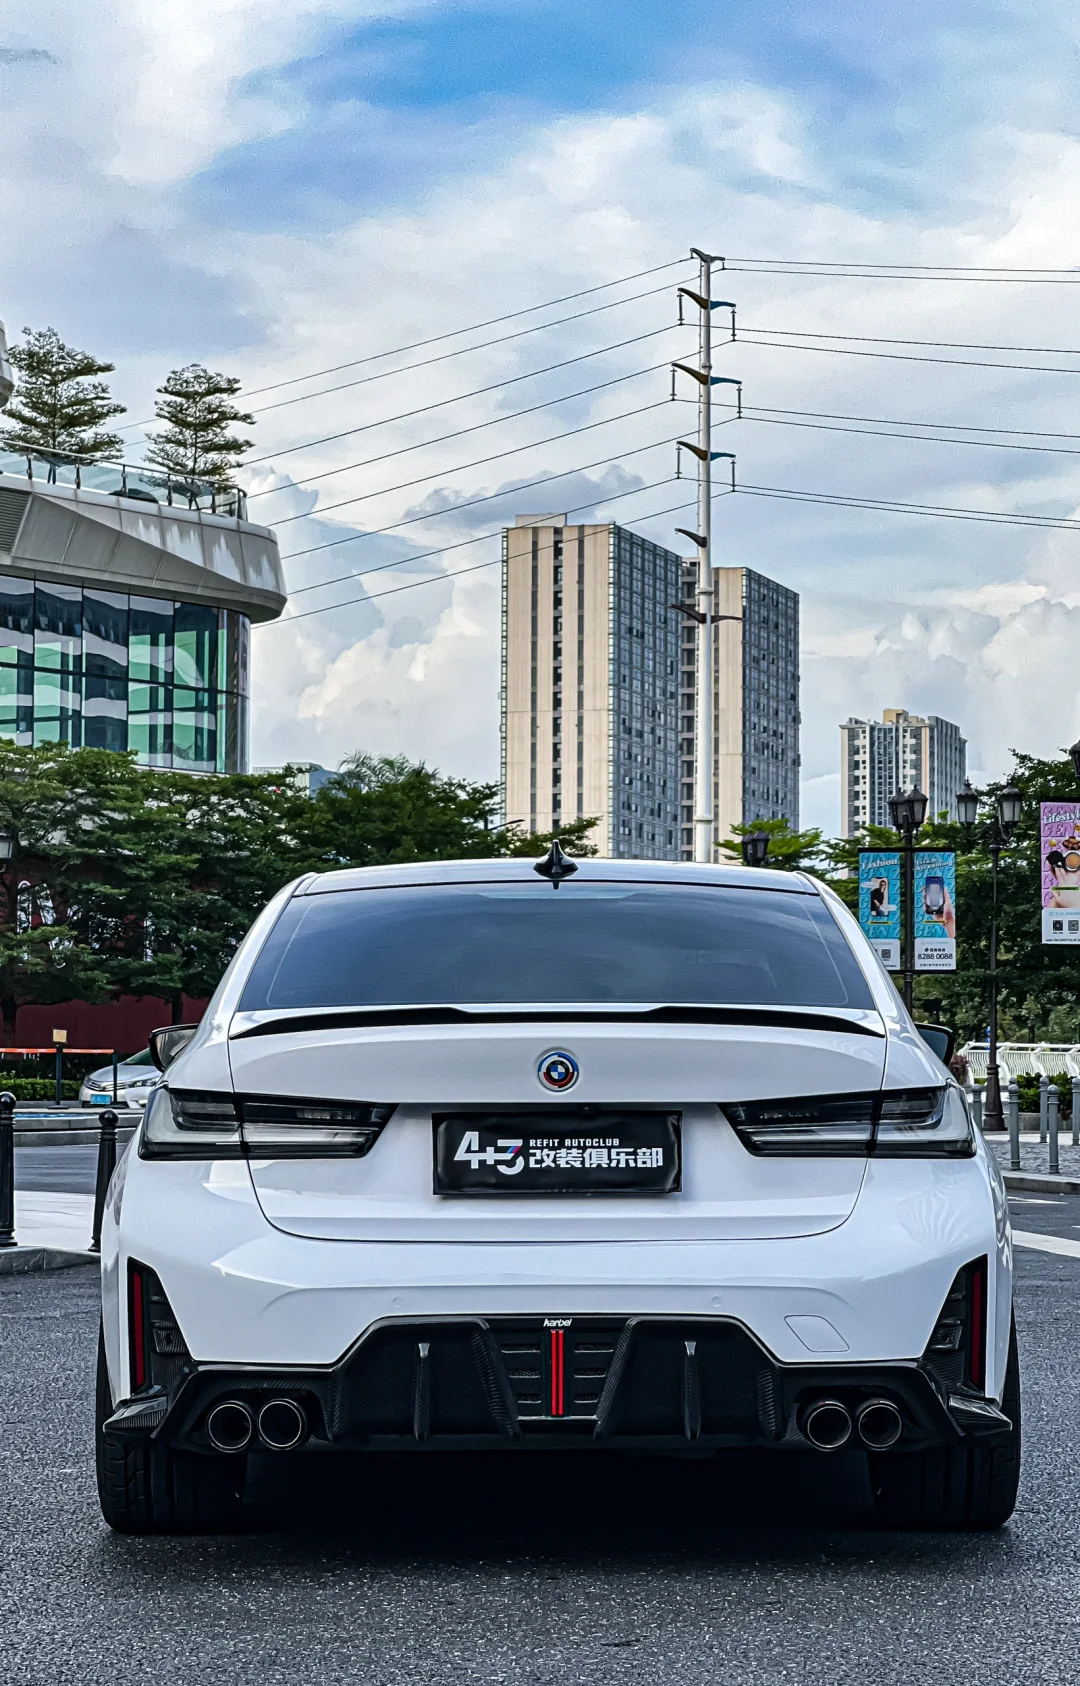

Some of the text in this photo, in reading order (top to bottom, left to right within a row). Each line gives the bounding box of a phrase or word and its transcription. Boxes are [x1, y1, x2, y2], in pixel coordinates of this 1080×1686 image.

[1043, 808, 1080, 824] Lifestyl
[862, 859, 898, 869] Fashion
[529, 1138, 620, 1147] REFIT AUTOCLUB
[529, 1147, 664, 1168] 改装俱乐部
